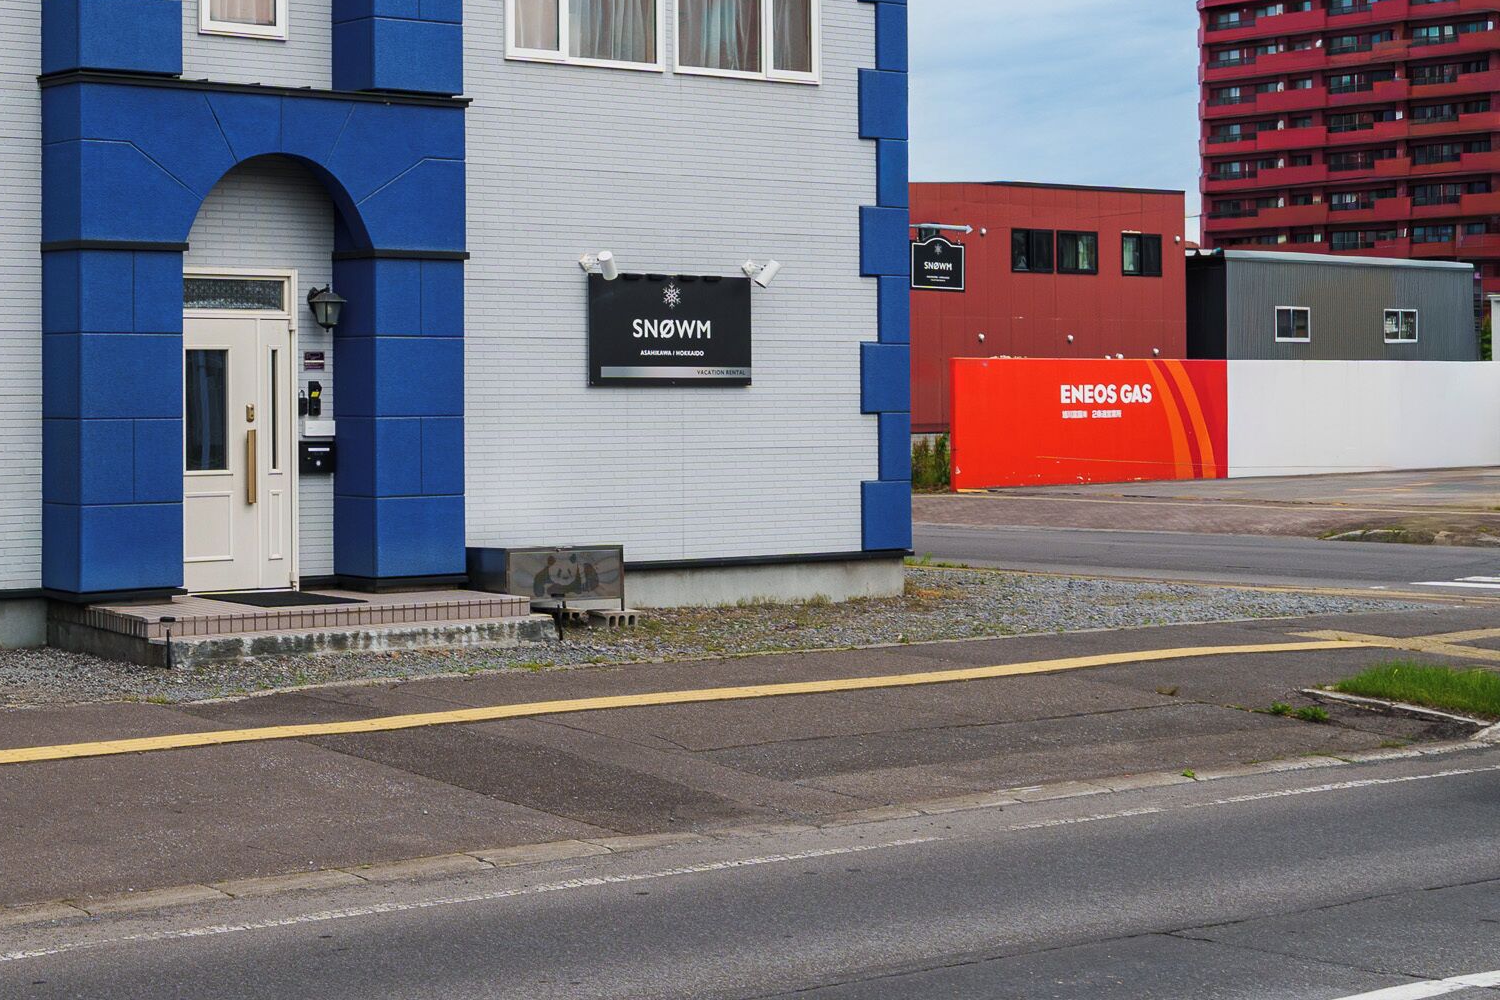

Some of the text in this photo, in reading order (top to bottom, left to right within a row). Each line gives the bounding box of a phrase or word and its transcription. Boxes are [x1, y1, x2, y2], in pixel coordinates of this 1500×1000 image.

[632, 318, 711, 339] SNØWM
[1060, 384, 1153, 404] ENEOS GAS
